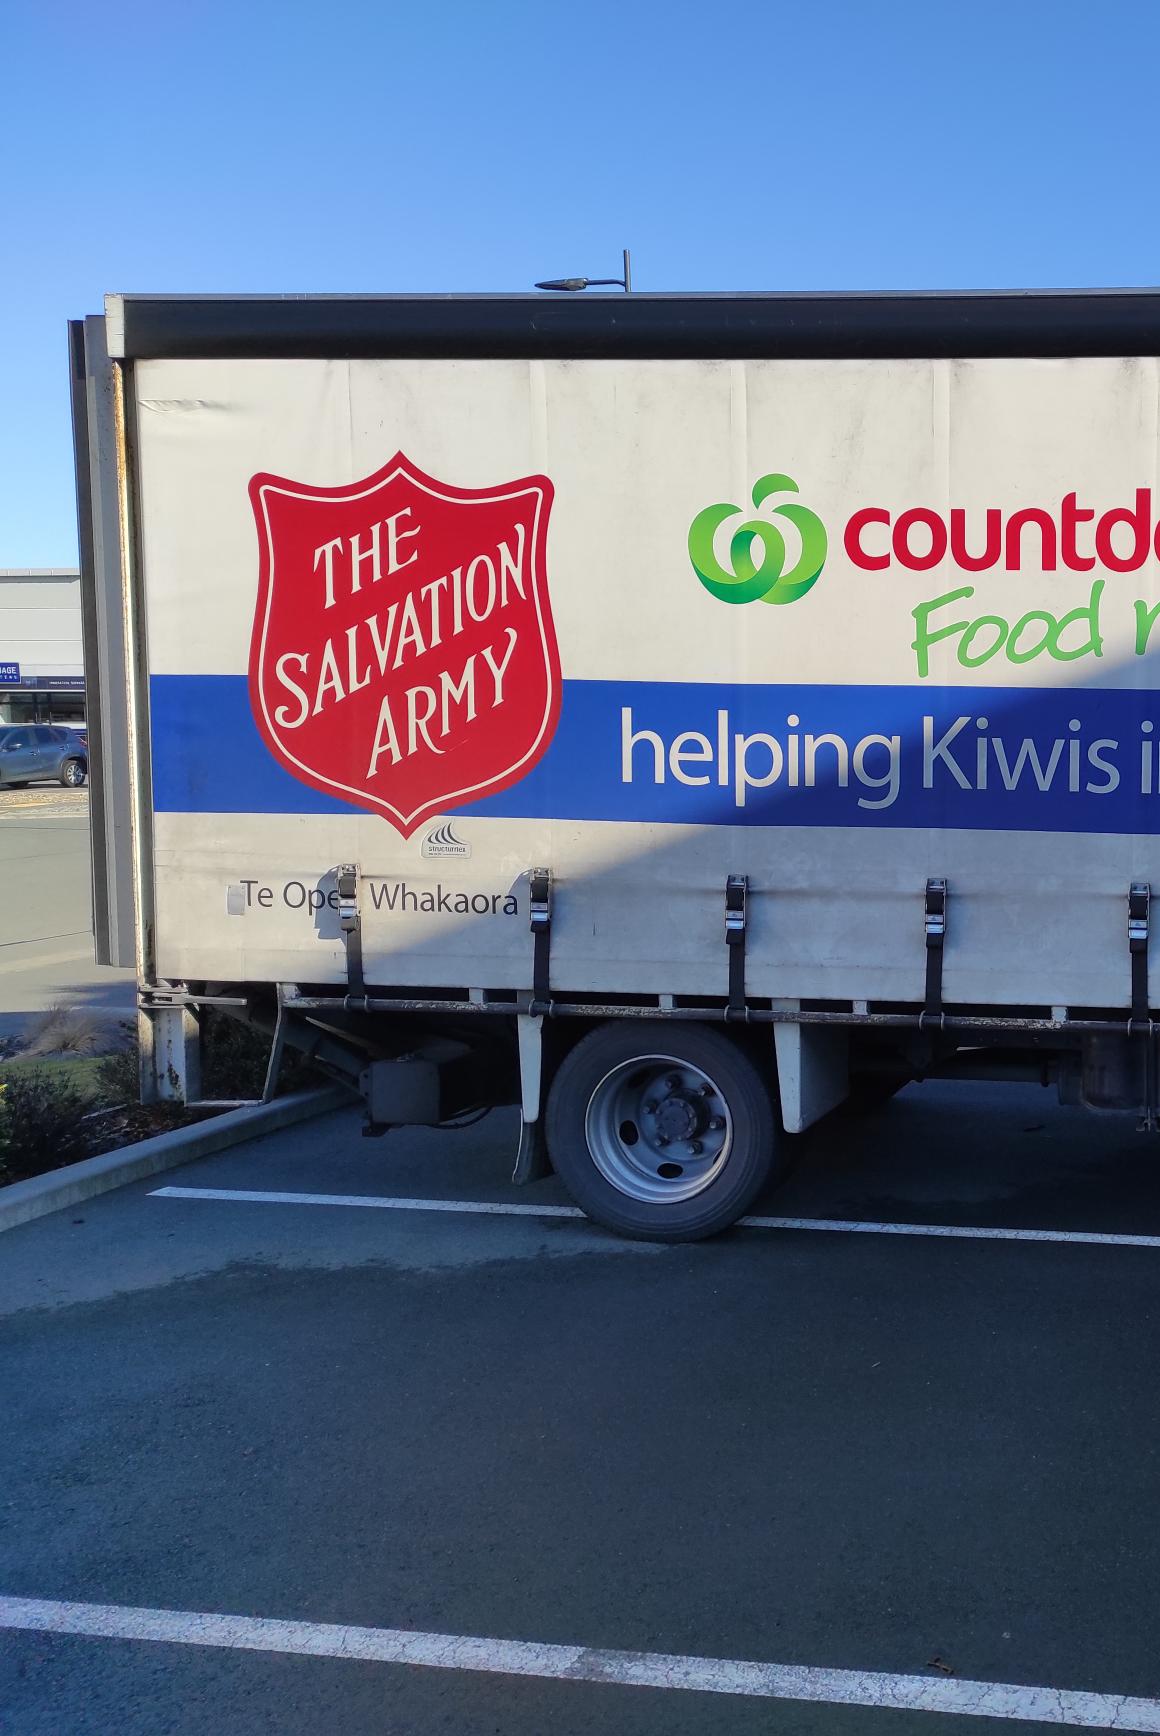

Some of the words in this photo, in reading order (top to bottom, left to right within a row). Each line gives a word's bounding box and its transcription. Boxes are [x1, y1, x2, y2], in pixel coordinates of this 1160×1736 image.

[313, 506, 421, 609] THE
[273, 522, 528, 729] SALVATION
[910, 579, 1105, 678] Food
[365, 626, 518, 780] ARMY
[621, 706, 902, 810] helping
[922, 716, 1121, 795] Kiwis
[239, 880, 274, 908] Te
[282, 881, 340, 916] Ope
[369, 883, 519, 915] Whakaora
